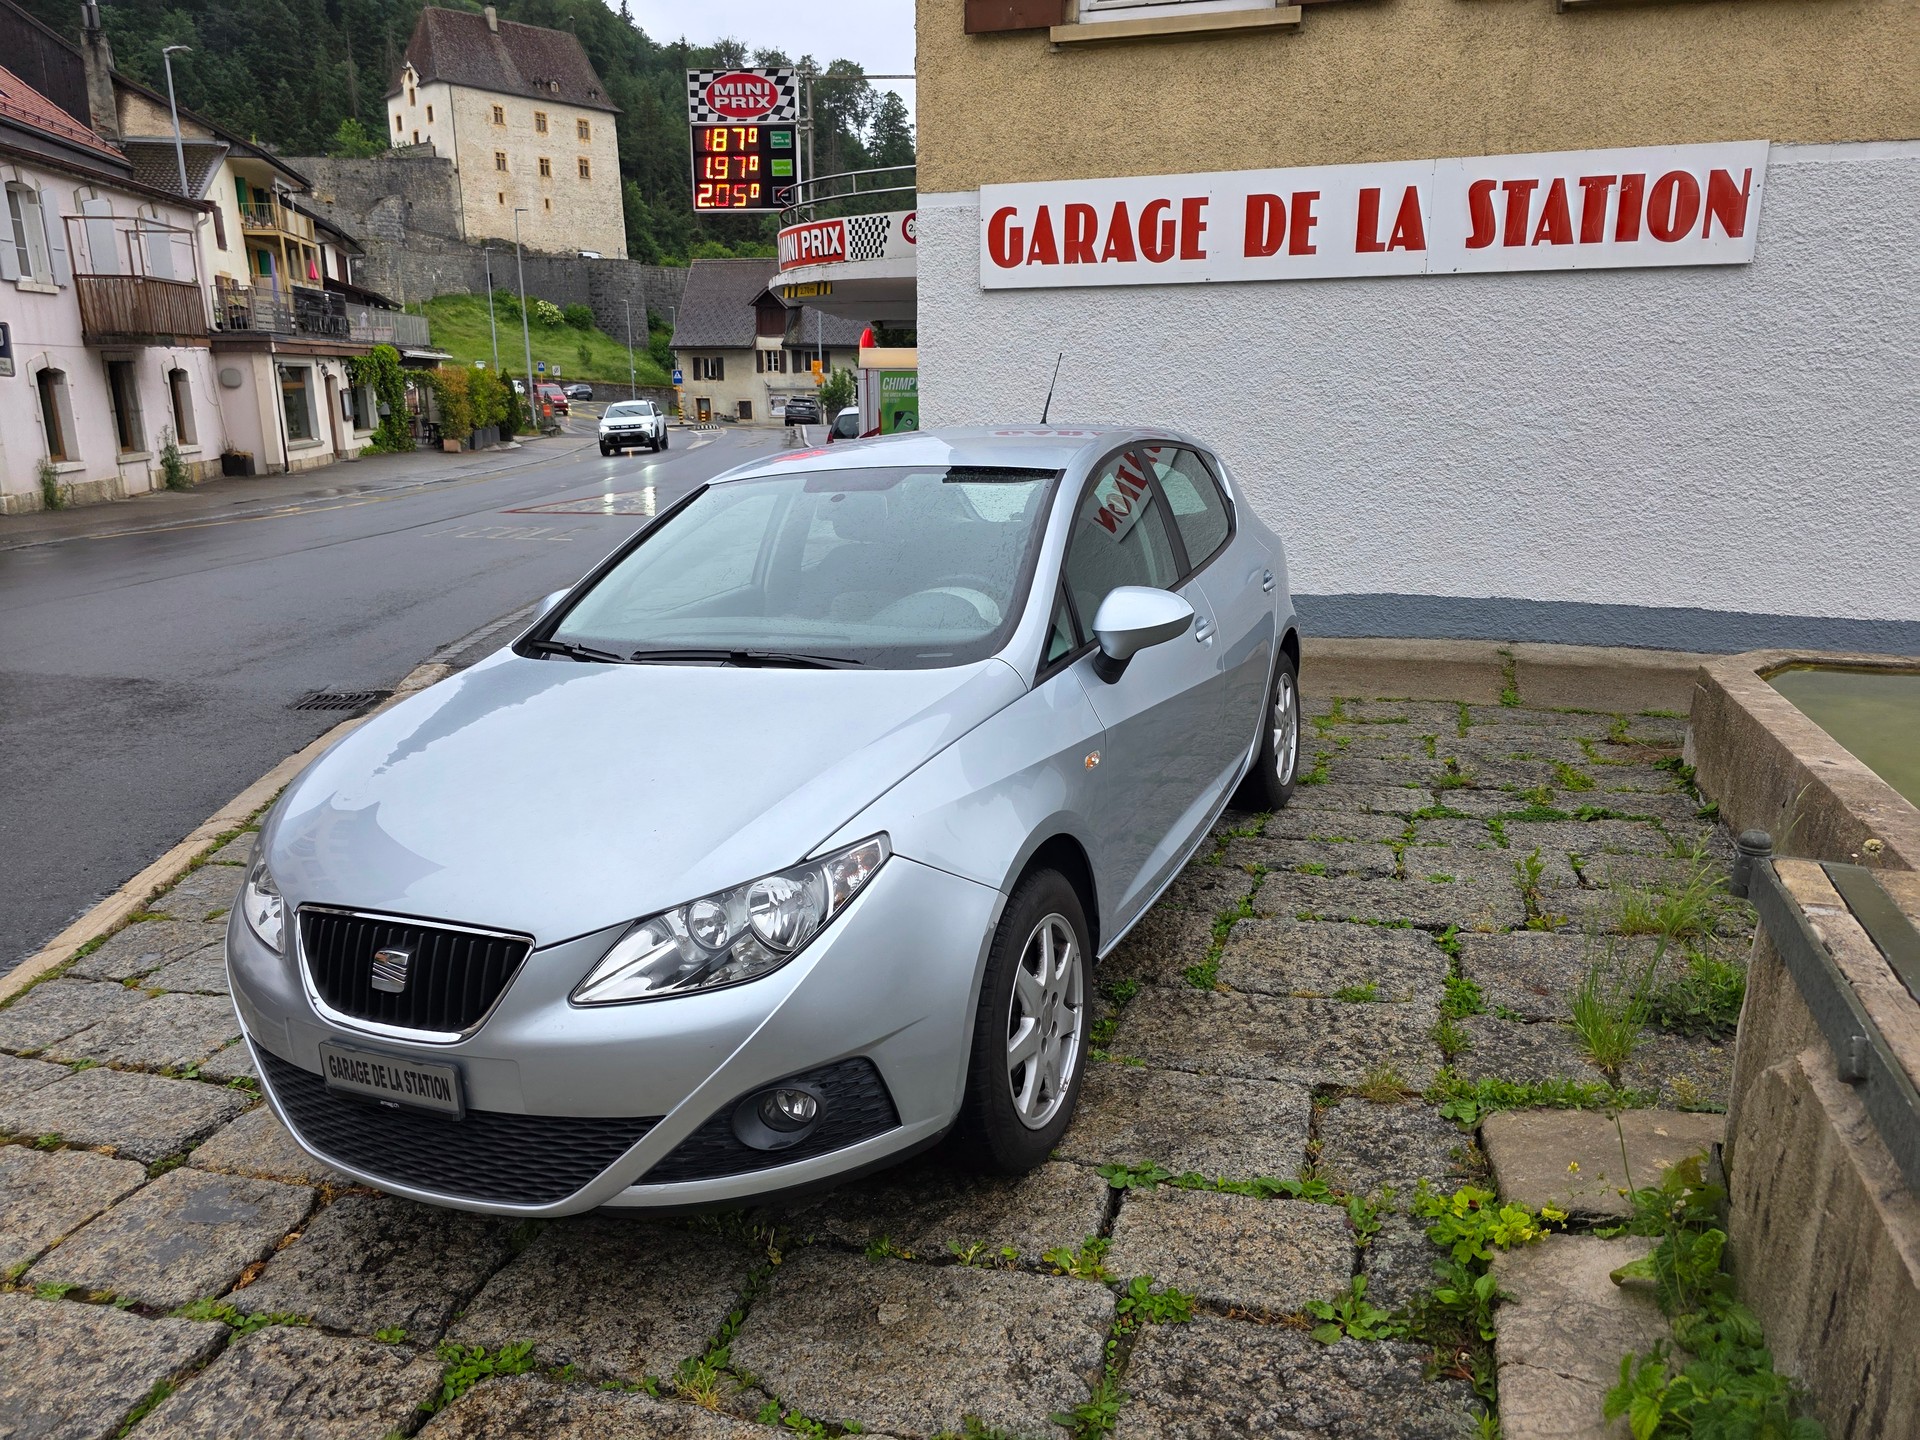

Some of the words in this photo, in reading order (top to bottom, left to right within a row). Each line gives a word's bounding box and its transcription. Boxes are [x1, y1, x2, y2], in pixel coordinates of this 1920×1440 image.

[714, 82, 770, 96] MINI
[714, 96, 771, 109] PRIX
[987, 196, 1209, 269] GARAGE
[1243, 190, 1321, 258] DE
[1354, 185, 1426, 253] LA
[1465, 167, 1753, 249] STATION
[780, 232, 799, 263] MINI
[800, 225, 843, 259] PRIX
[328, 1054, 371, 1086] GARAGE
[371, 1063, 388, 1089] DE
[387, 1066, 404, 1093] LA
[403, 1070, 452, 1102] STATION
